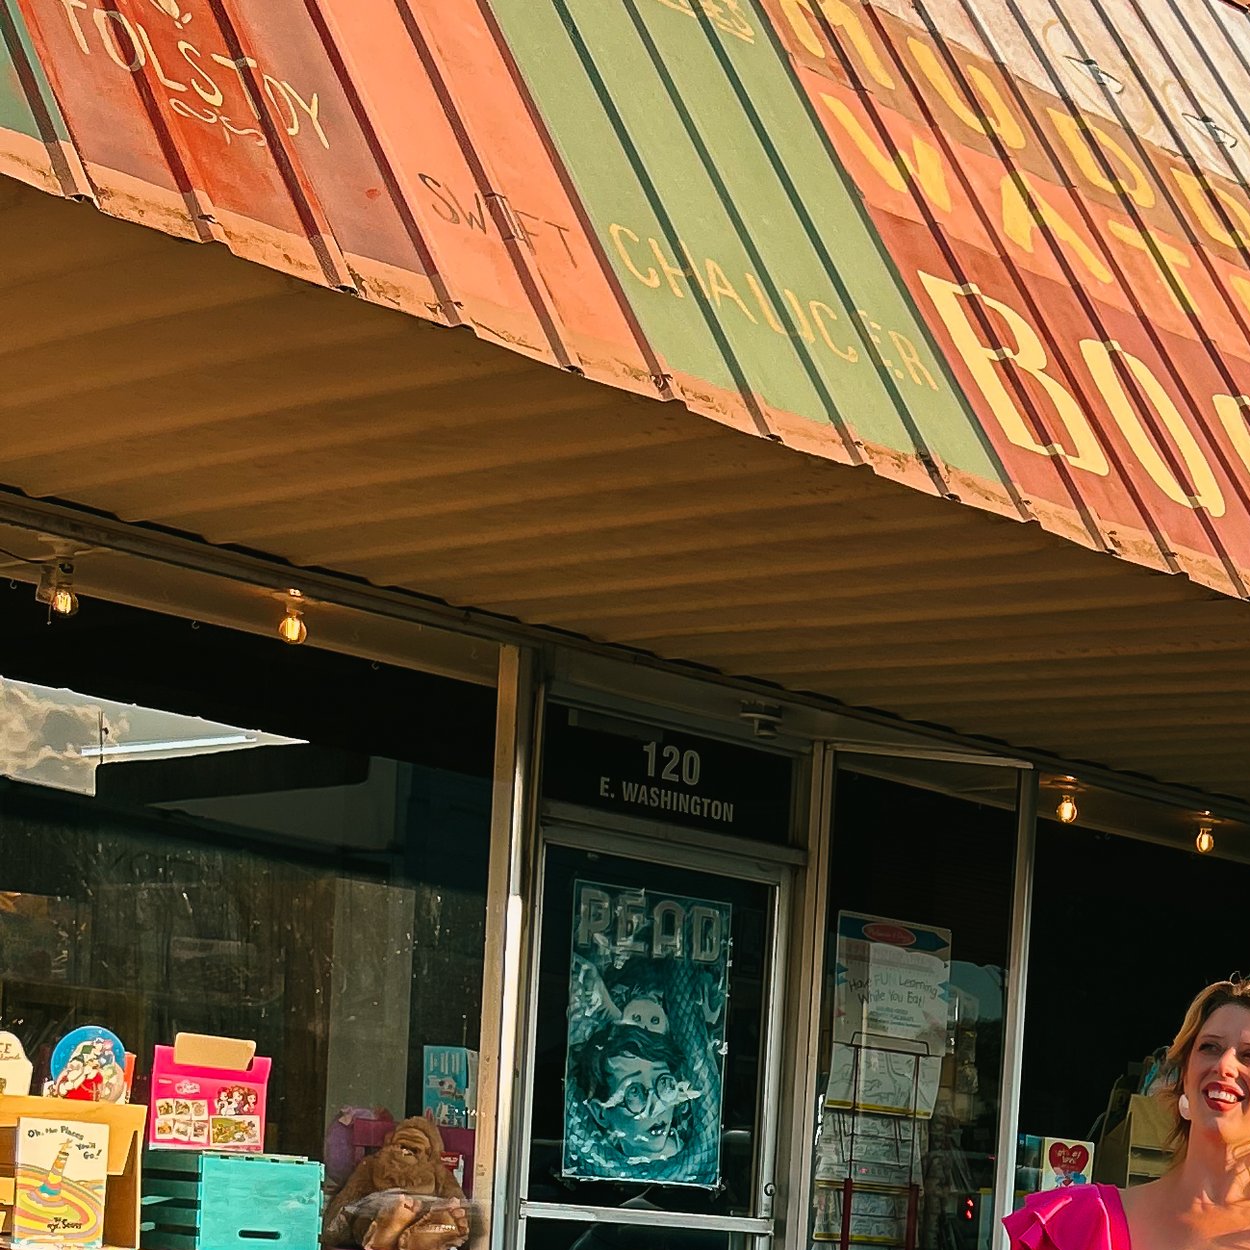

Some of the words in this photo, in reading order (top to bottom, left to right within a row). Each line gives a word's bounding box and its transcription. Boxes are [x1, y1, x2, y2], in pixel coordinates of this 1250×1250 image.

[417, 172, 580, 269] SWIFT
[609, 223, 940, 392] CHAUCER
[600, 776, 615, 799] E.
[622, 780, 734, 822] WASHINGTON
[643, 741, 700, 786] 120
[577, 888, 722, 963] READ
